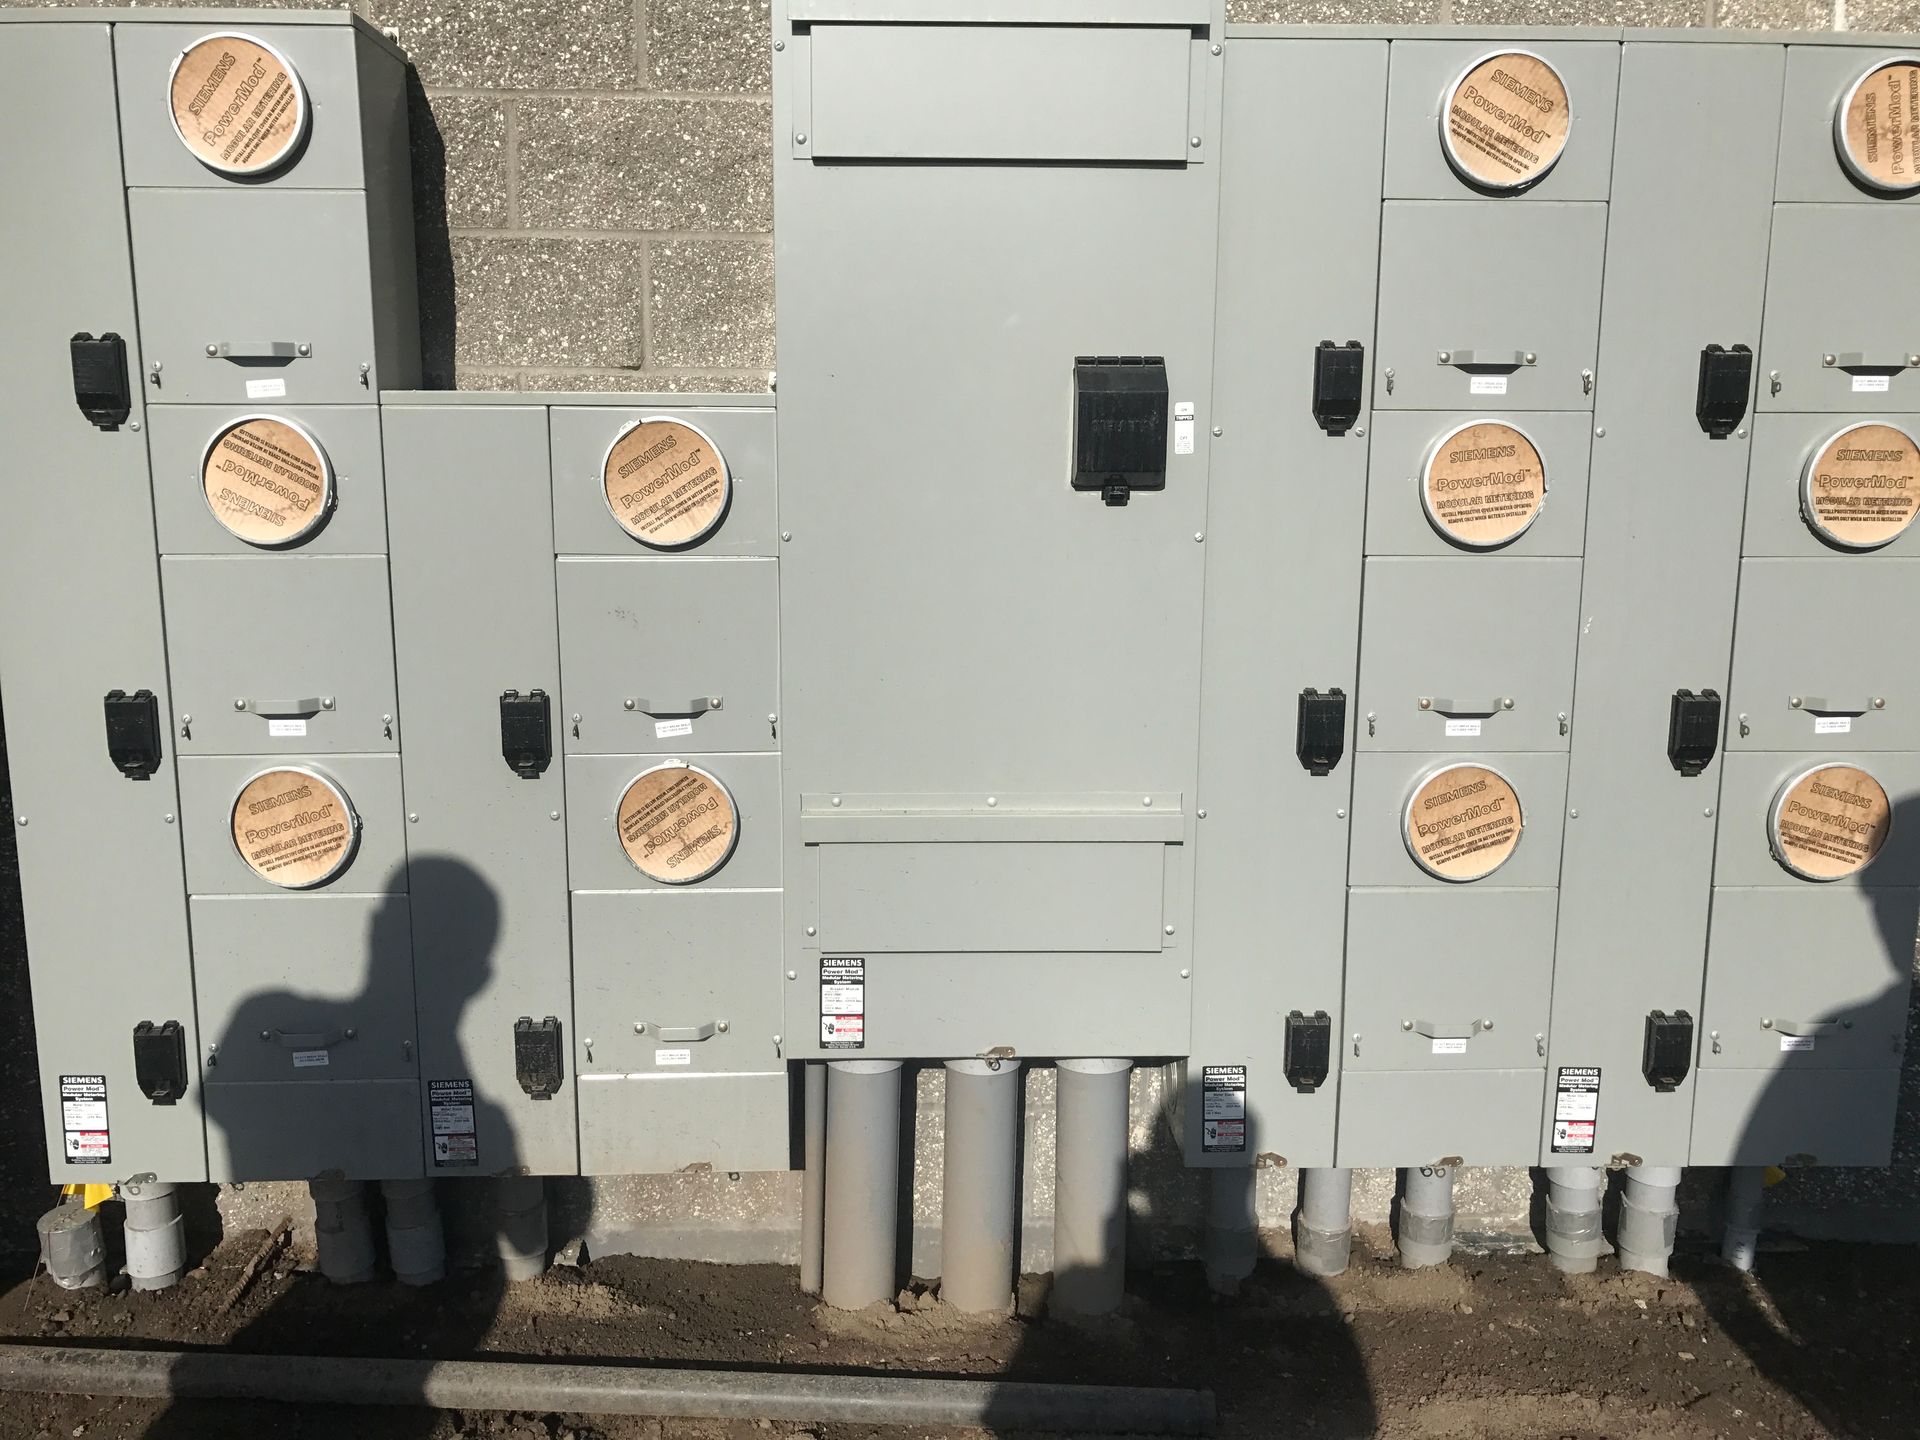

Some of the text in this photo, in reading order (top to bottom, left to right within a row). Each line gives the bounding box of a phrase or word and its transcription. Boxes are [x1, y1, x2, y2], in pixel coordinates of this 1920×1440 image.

[187, 51, 237, 116] SIEMENS
[1490, 68, 1554, 114] SIEMENS
[219, 71, 287, 160] MODULAR METERING
[232, 148, 245, 164] INSTALL
[242, 127, 260, 149] PROTECTIVE
[257, 115, 269, 128] COVER
[269, 99, 280, 112] METER
[277, 82, 292, 100] OPENING
[1866, 92, 1877, 162] SIEMENS
[1909, 69, 1920, 173] MODULAR METERING
[1450, 118, 1465, 130] INSTALL
[1464, 127, 1485, 143] PROTECTIVE
[1484, 139, 1497, 150] COVER
[1501, 149, 1514, 160] METER
[1512, 156, 1530, 170] OPENING
[1451, 104, 1539, 164] MODULAR METERING
[230, 432, 249, 445] OPENING
[249, 441, 262, 451] METER
[1449, 444, 1515, 463] SIEMENS
[222, 438, 319, 493] MODULAR METERING
[267, 450, 280, 460] COVER
[280, 457, 303, 472] PROTECTIVE
[617, 434, 677, 479] SIEMENS
[1836, 449, 1903, 461] SIEMENS
[303, 468, 319, 480] INSTALL
[219, 487, 286, 527] SIEMENS
[630, 465, 717, 525] MODULAR METERING
[1436, 490, 1534, 508] MODULAR METERING
[1816, 497, 1911, 505] MODULAR METERING
[664, 786, 684, 802] PROTECTIVE
[682, 777, 697, 789] INSTALL
[1423, 780, 1486, 809] SIEMENS
[1810, 781, 1872, 809] SIEMENS
[248, 784, 311, 815] SIEMENS
[626, 781, 707, 843] MODULAR METERING
[653, 800, 665, 810] COVER
[622, 819, 639, 833] OPENING
[638, 811, 650, 821] METER
[251, 822, 344, 860] MODULAR METERING
[258, 858, 274, 866] INSTALL
[274, 850, 297, 861] PROTECTIVE
[297, 846, 310, 854] COVER
[315, 840, 327, 848] METER
[327, 835, 344, 844] OPENING
[665, 824, 722, 869] SIEMENS
[1421, 815, 1513, 854] MODULAR METERING
[1428, 851, 1443, 860] INSTALL
[1443, 844, 1465, 855] PROTECTIVE
[1465, 839, 1477, 847] COVER
[1482, 833, 1495, 841] METER
[1495, 827, 1513, 837] OPENING
[1780, 819, 1869, 852] MODULAR METERING
